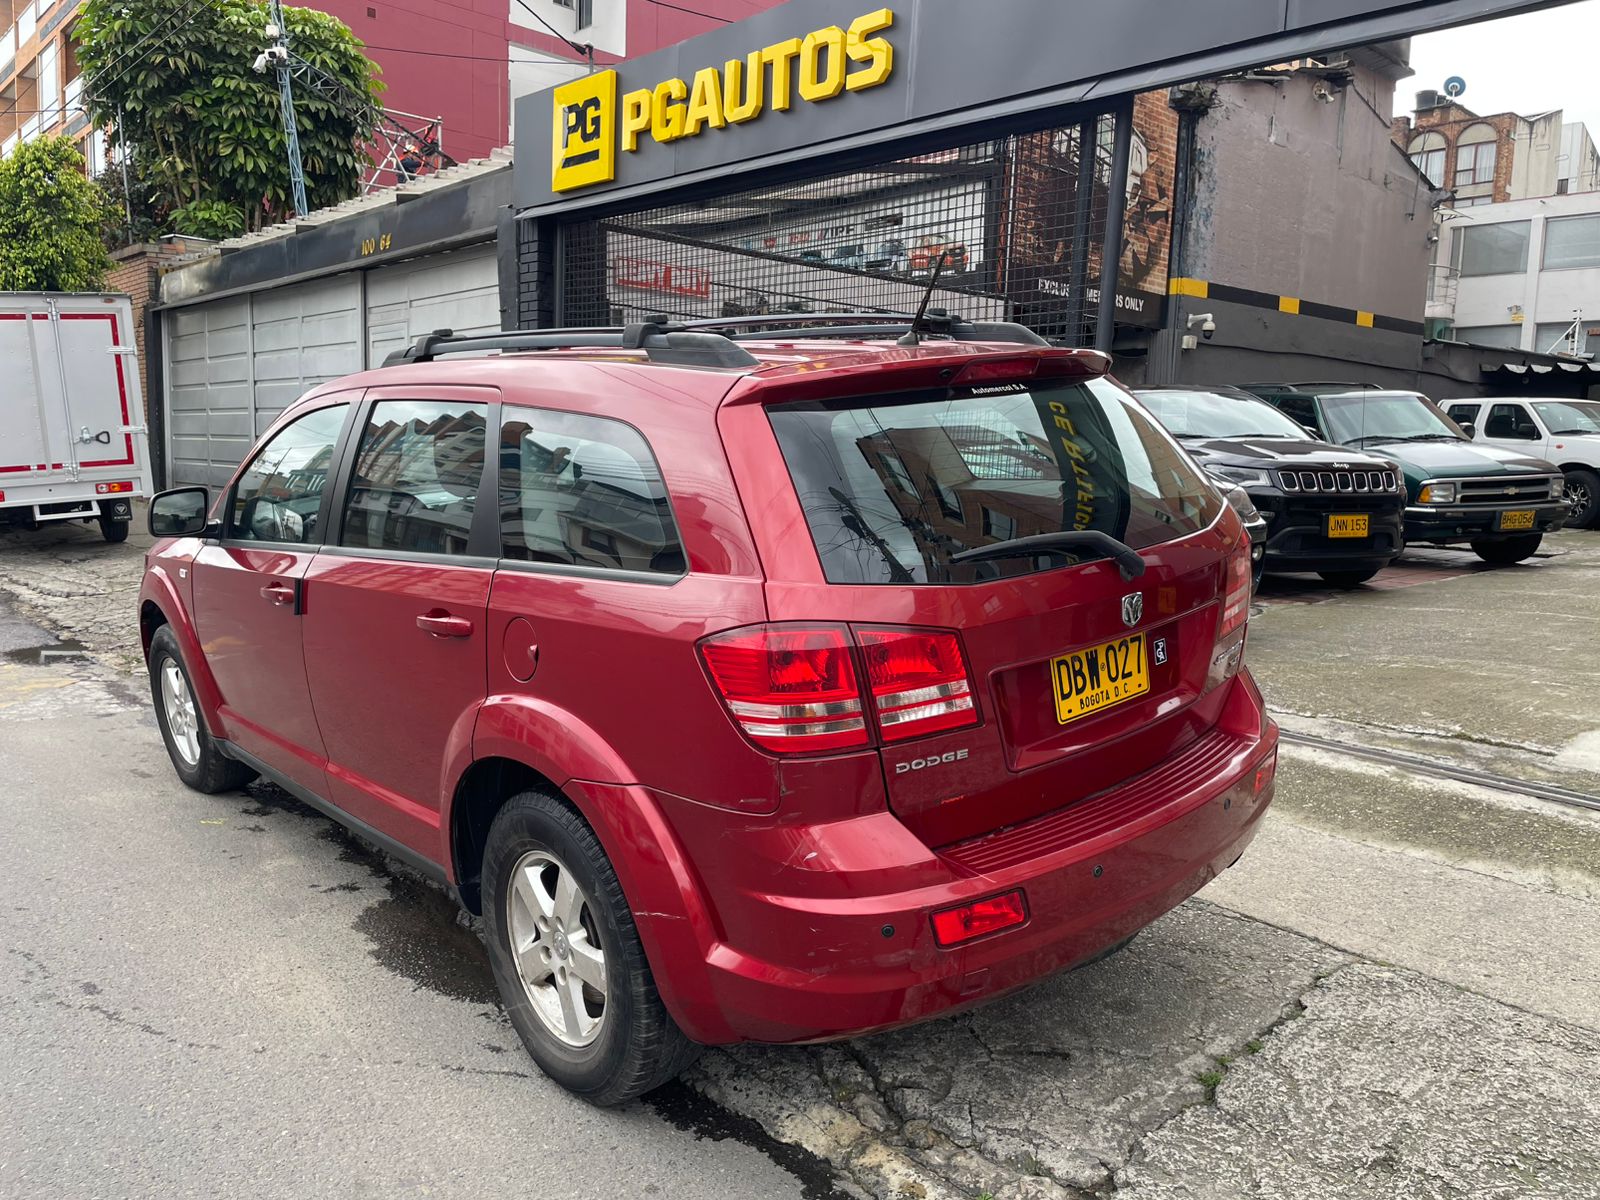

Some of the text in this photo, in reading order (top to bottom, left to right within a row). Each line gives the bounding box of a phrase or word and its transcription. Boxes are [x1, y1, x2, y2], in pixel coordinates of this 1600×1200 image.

[621, 8, 894, 152] PGAUTOS
[562, 96, 601, 150] PG
[361, 238, 375, 256] 100
[1124, 296, 1145, 312] ONLY
[1332, 462, 1350, 470] Jeep
[1331, 518, 1367, 532] JNN 153
[1056, 635, 1142, 701] DBW 027
[1079, 689, 1110, 710] BOGOTA
[895, 749, 969, 774] DODGE
